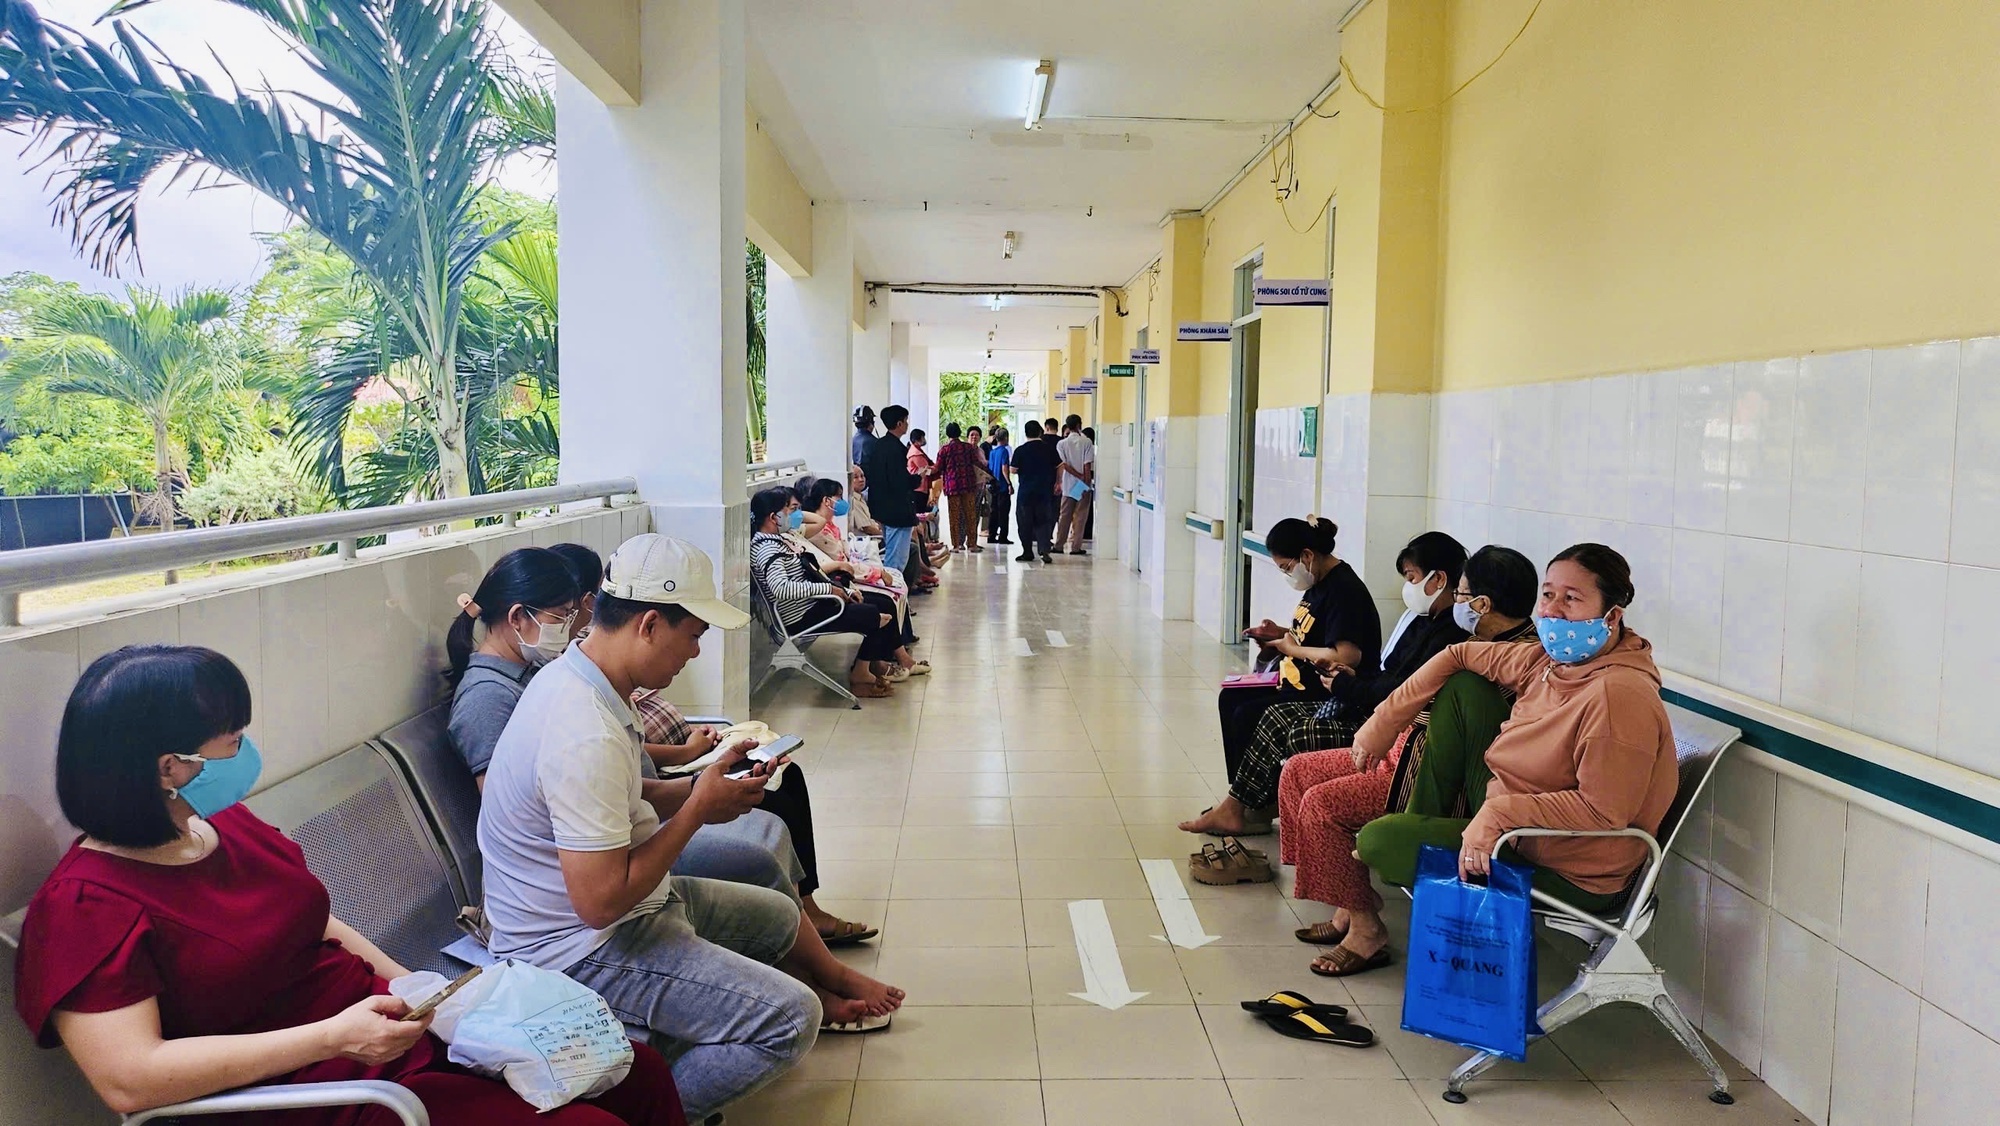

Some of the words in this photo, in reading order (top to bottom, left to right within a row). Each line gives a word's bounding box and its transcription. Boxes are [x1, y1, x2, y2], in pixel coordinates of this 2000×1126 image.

[1257, 287, 1279, 295] PHÒNG
[1428, 950, 1438, 963] X
[1451, 956, 1504, 977] QUANG
